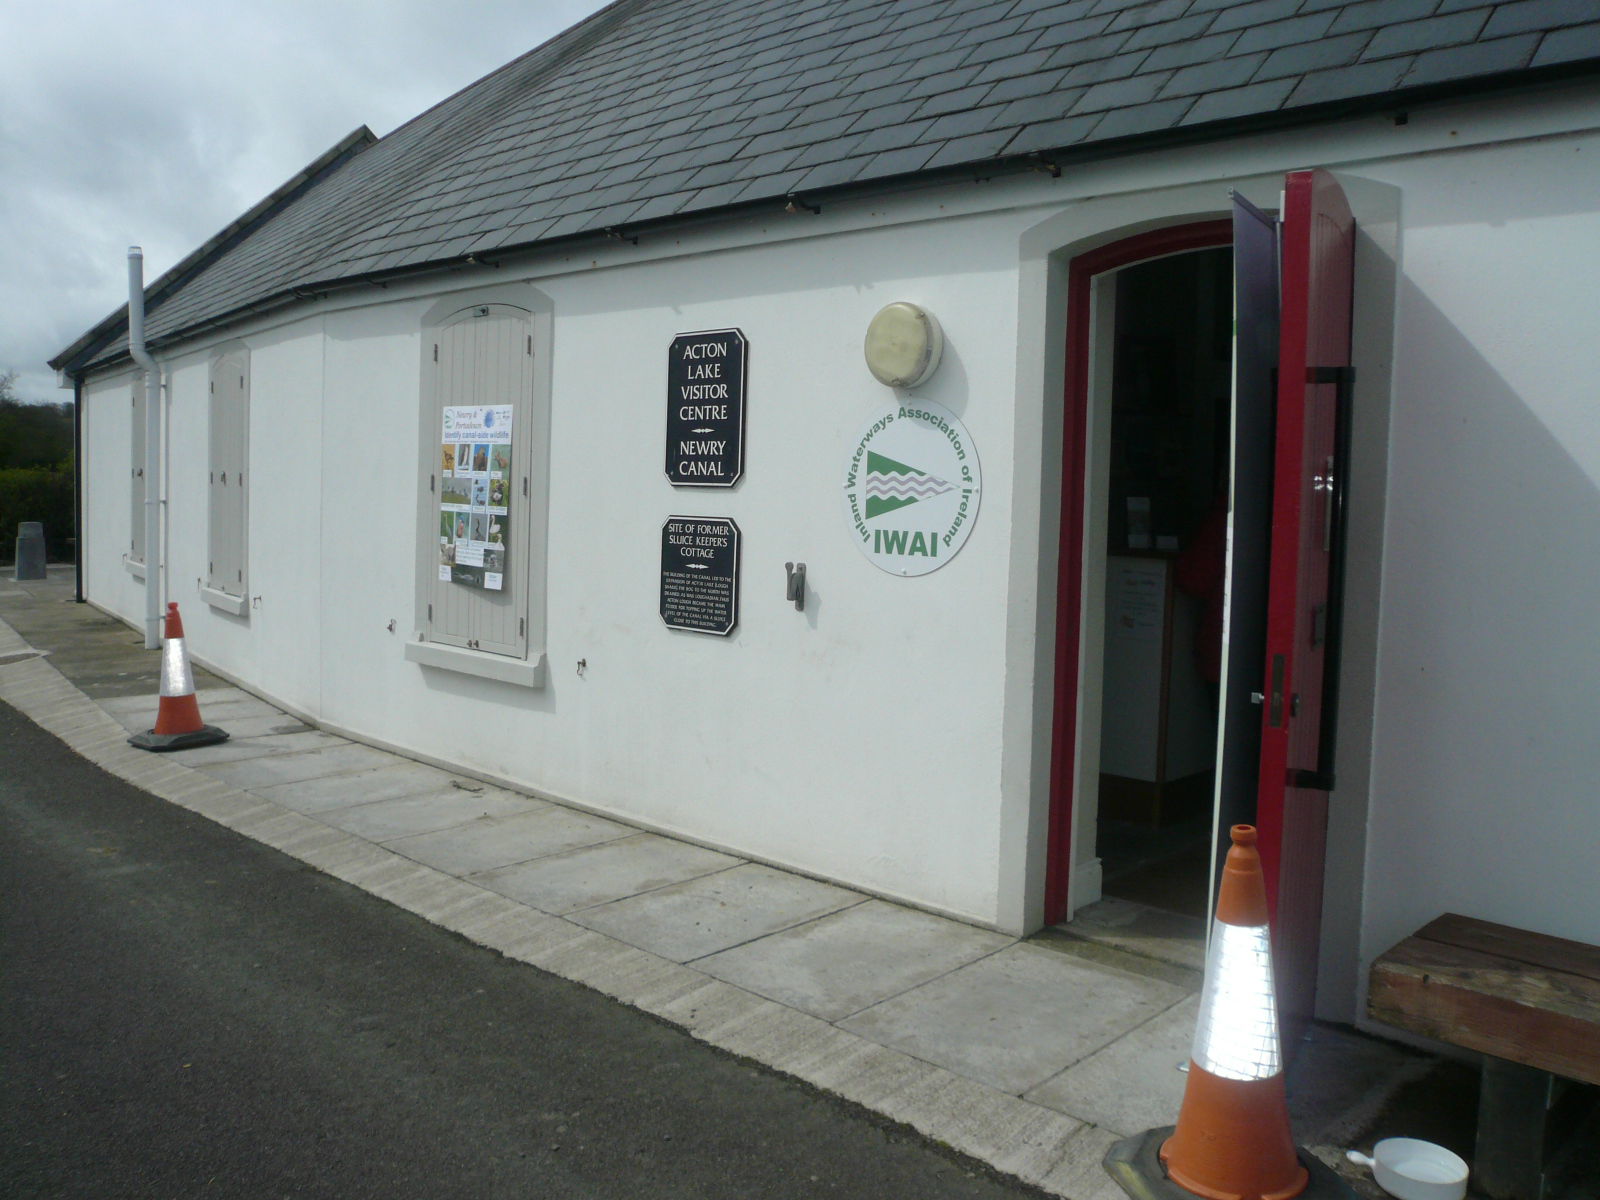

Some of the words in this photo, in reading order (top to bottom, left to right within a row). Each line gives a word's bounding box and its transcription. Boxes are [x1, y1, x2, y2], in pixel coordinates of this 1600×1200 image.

[683, 342, 727, 360] ACTON
[688, 363, 721, 379] LAKE
[681, 384, 728, 400] VISITOR
[680, 405, 727, 420] CENTRE
[898, 407, 966, 460] Association
[680, 441, 726, 455] NEWRY
[847, 413, 894, 489] Waterways
[679, 461, 724, 476] CANAL
[961, 465, 972, 483] of
[848, 493, 871, 543] Inland
[942, 488, 972, 547] Ireland
[668, 524, 683, 532] SITE
[685, 524, 695, 533] OF
[698, 525, 729, 535] FORMER
[669, 535, 693, 545] SLUICE
[696, 537, 727, 547] KEEPER'S
[874, 529, 938, 557] IWAI
[681, 547, 714, 558] COTTAGE
